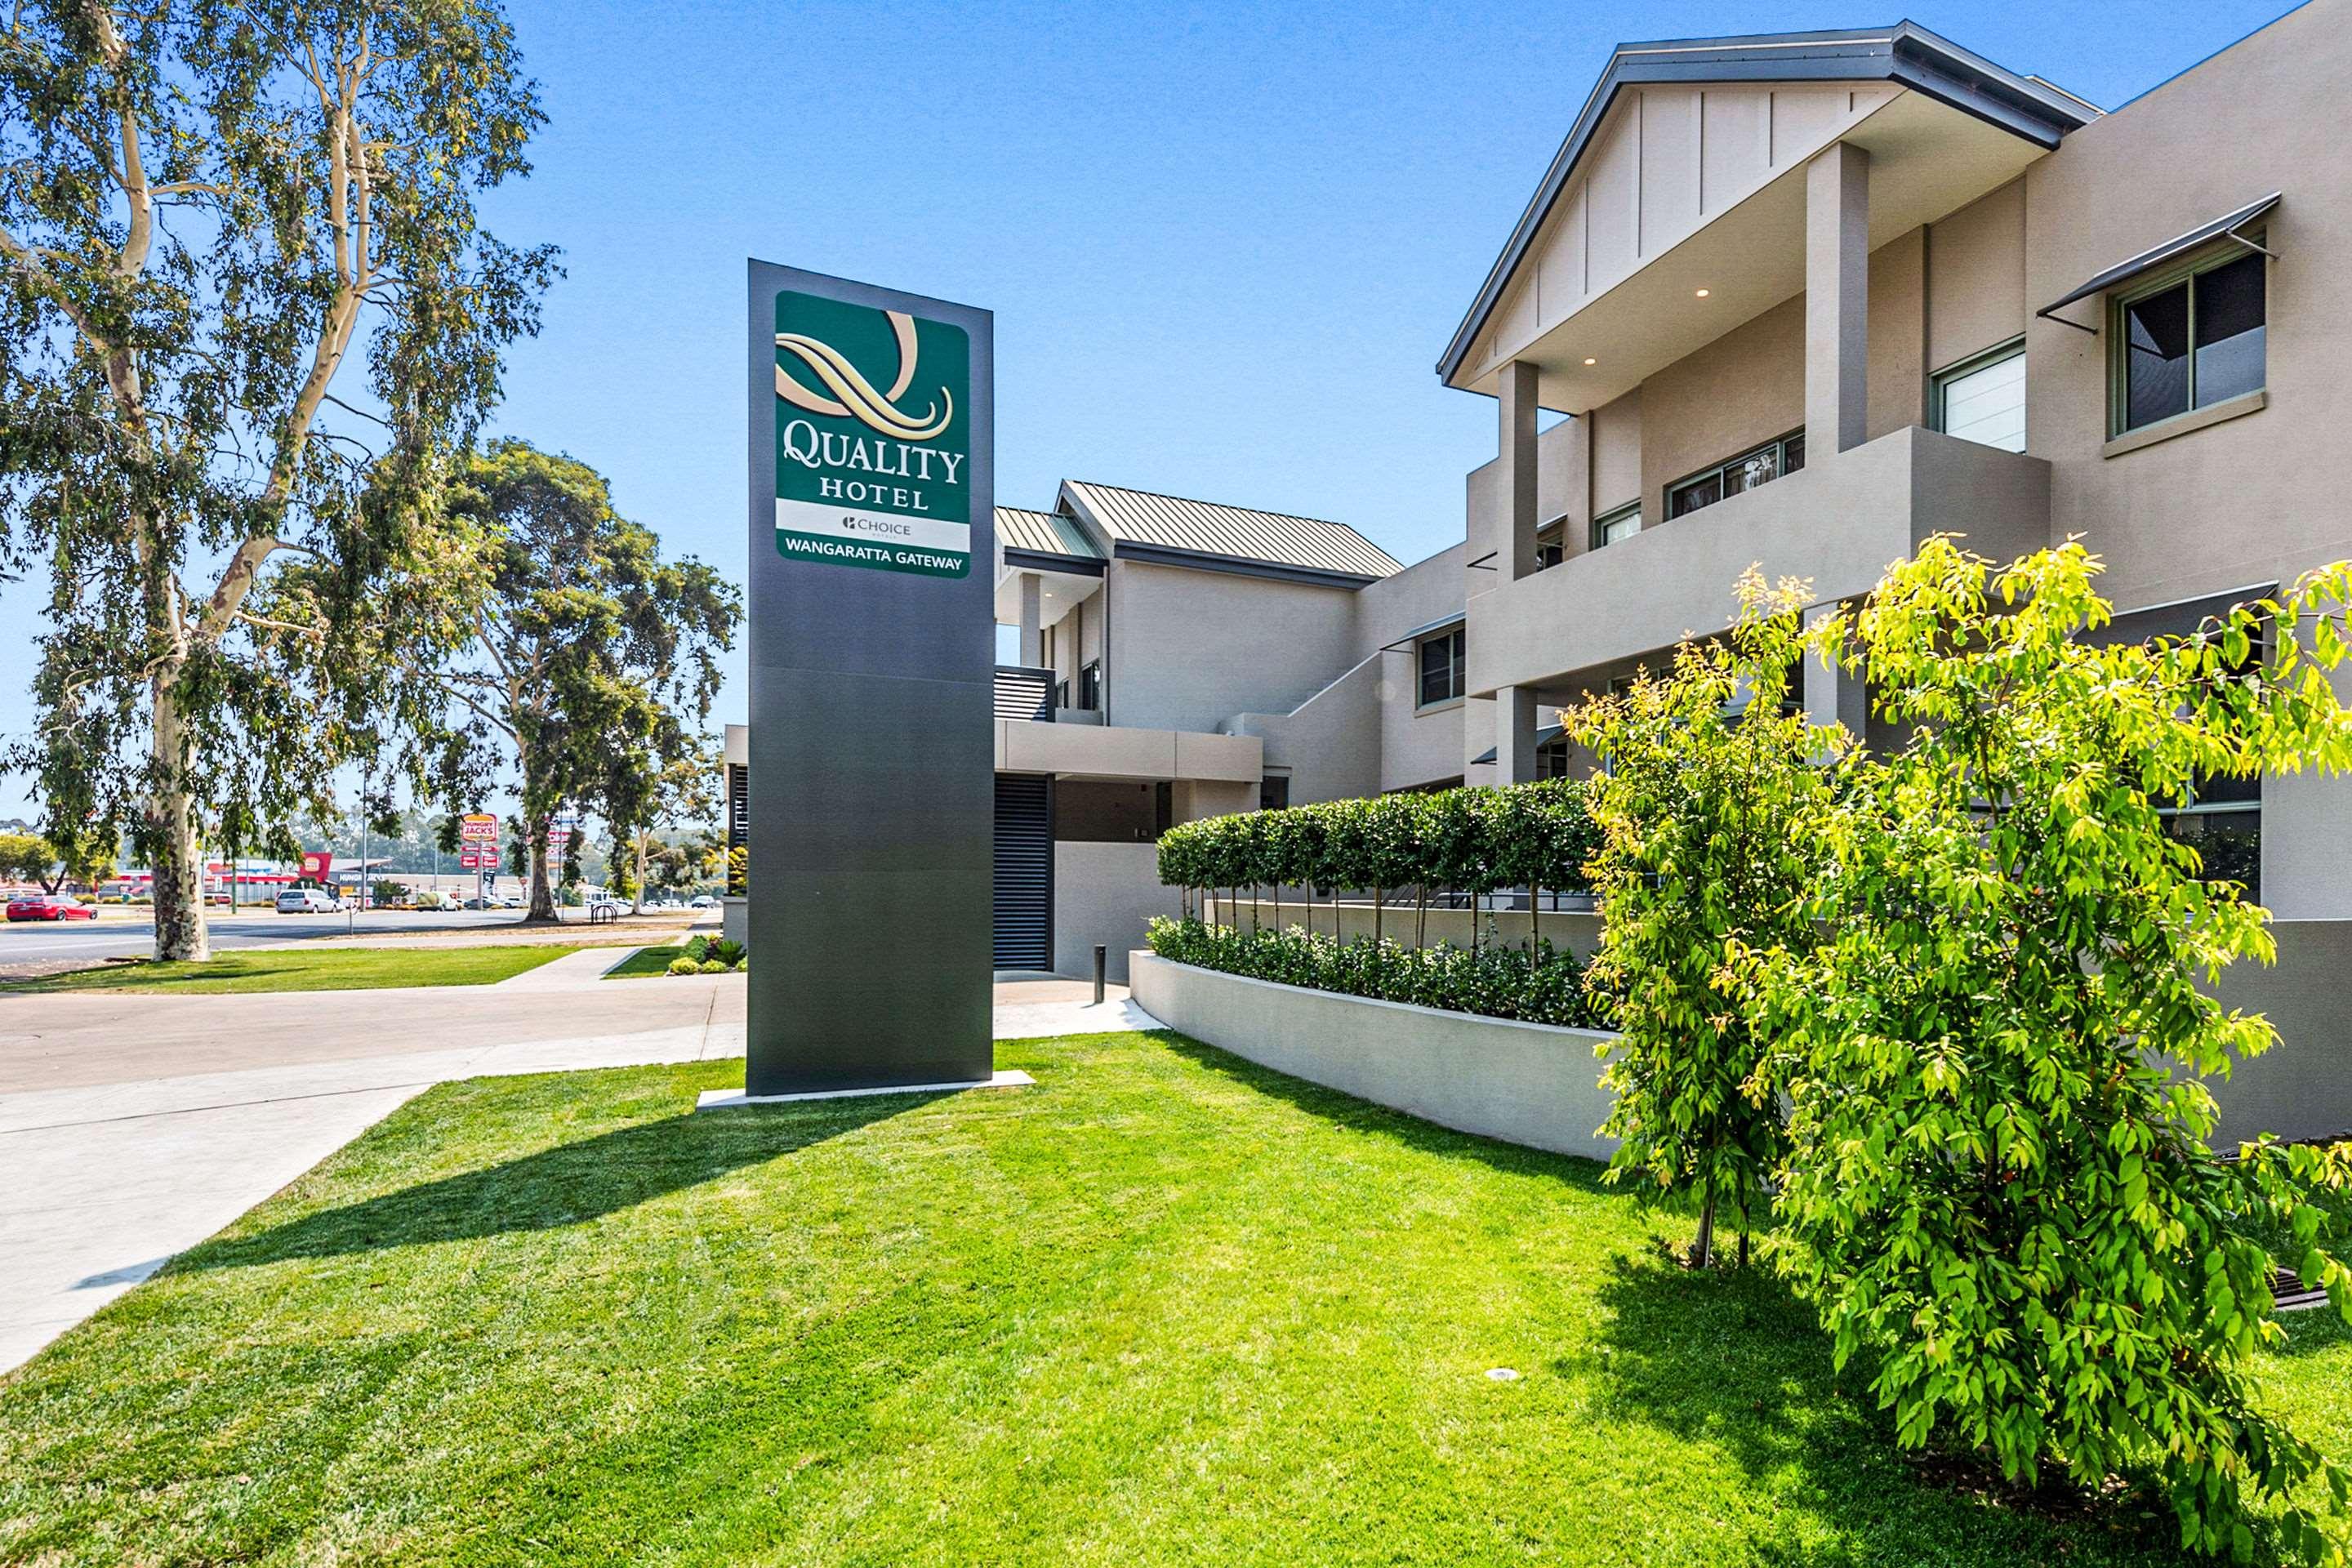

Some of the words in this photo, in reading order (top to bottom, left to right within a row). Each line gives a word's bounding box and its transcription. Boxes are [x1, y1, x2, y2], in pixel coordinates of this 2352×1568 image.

[783, 419, 964, 484] QUALITY
[819, 477, 929, 510] HOTEL
[858, 519, 911, 536] CHOICE
[785, 537, 891, 562] WANGARATTA
[895, 552, 963, 570] GATEWAY
[339, 874, 364, 882] HUNGR
